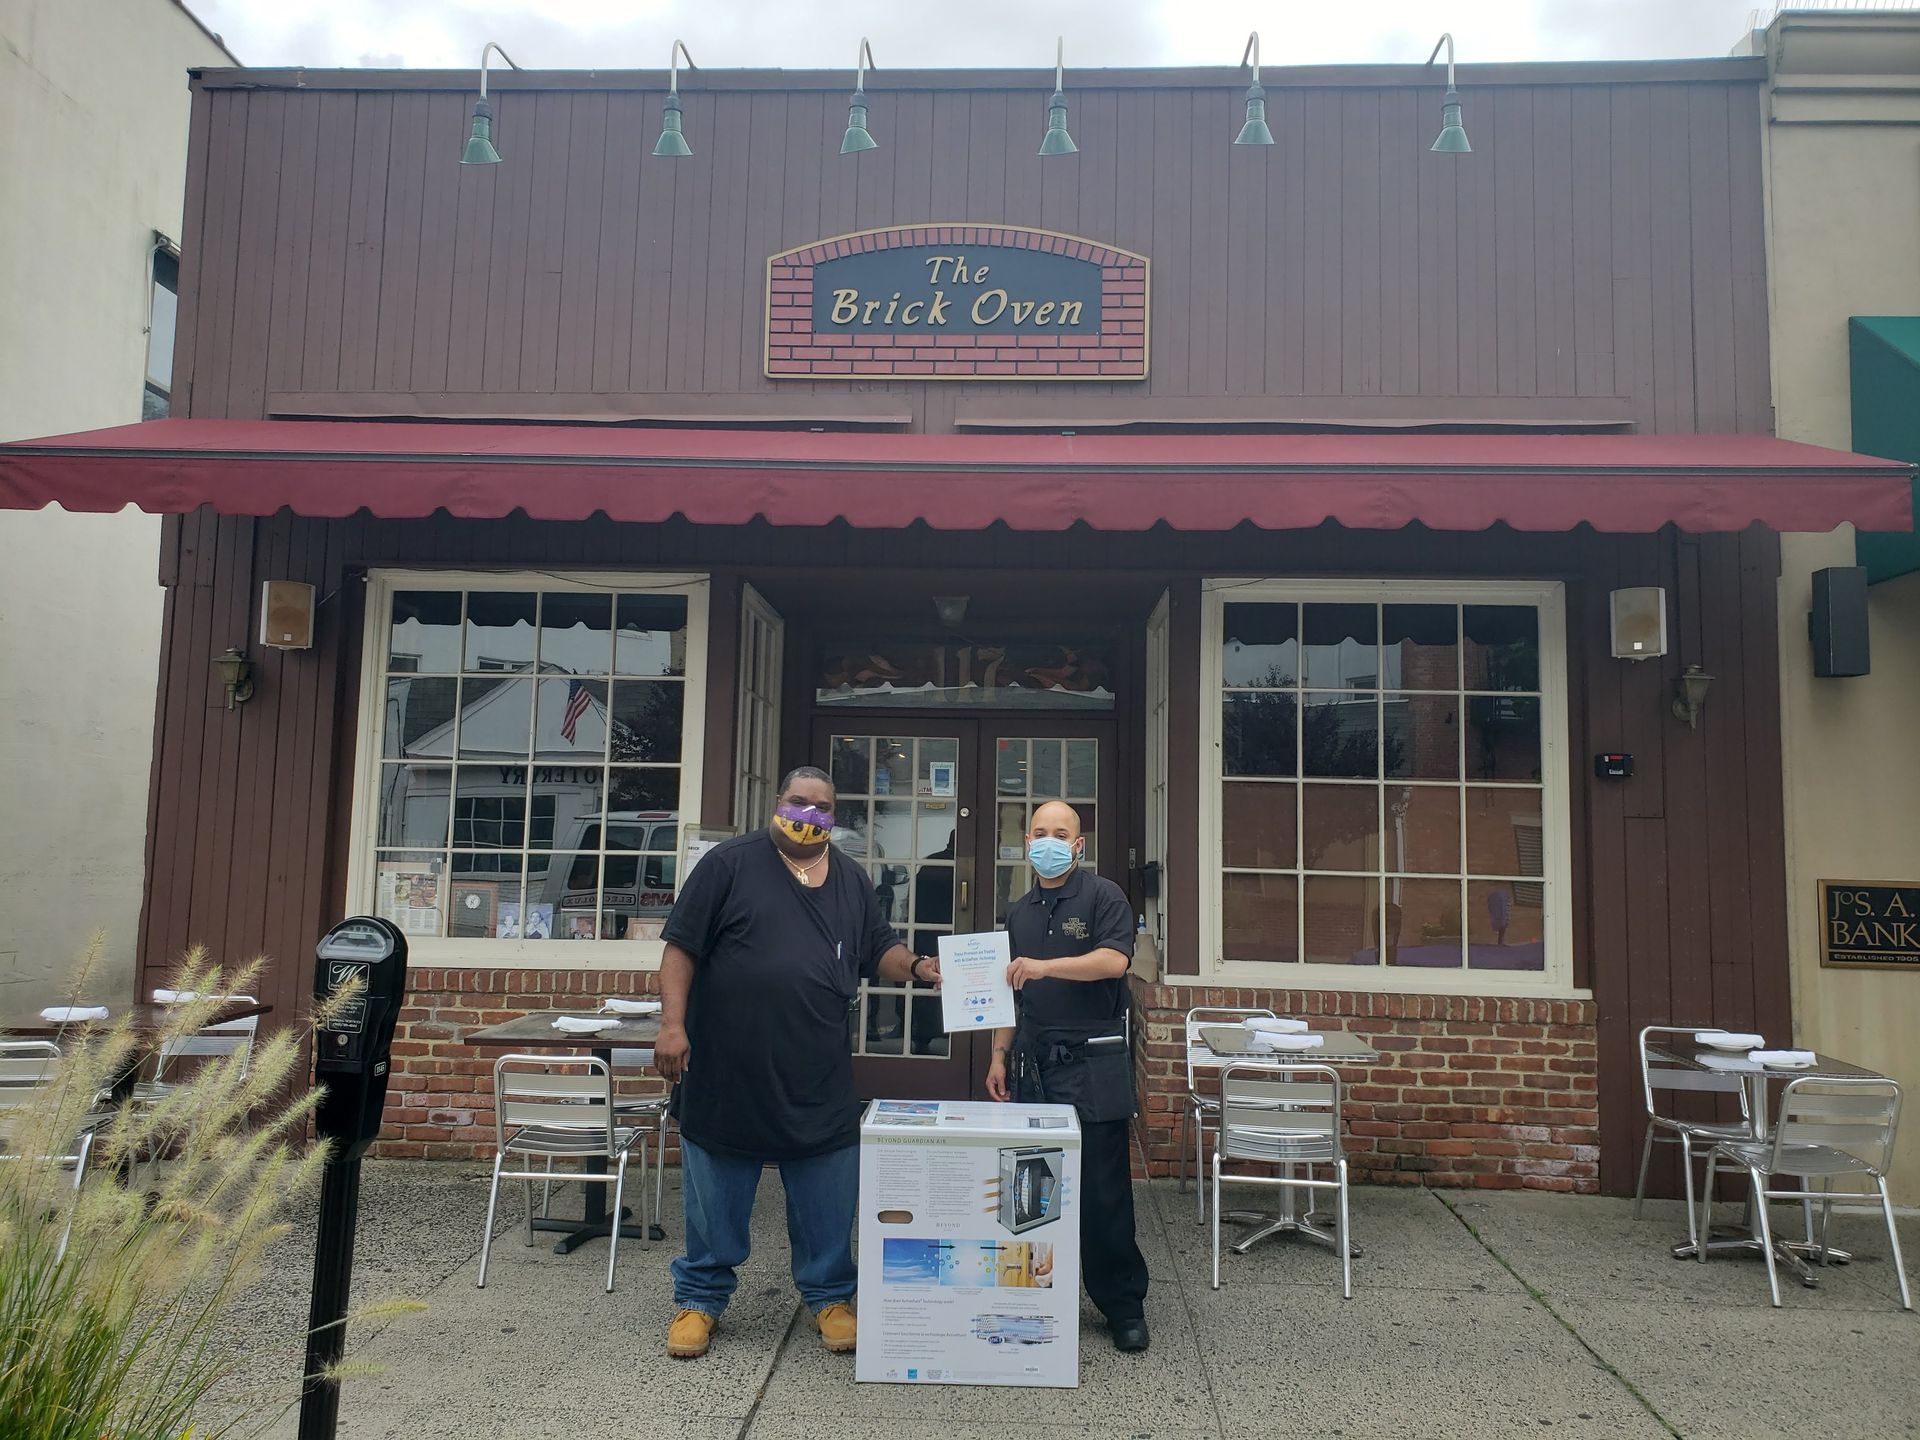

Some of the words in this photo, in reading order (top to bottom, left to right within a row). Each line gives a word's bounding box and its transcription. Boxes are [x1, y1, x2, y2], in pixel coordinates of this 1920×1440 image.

[924, 255, 990, 285] The
[829, 288, 953, 326] Brick
[970, 288, 1084, 327] Oven
[1883, 891, 1916, 918] A.
[1830, 920, 1920, 949] BANK
[1833, 953, 1895, 961] ESTABLISHED
[902, 1137, 935, 1145] GUARDIAN
